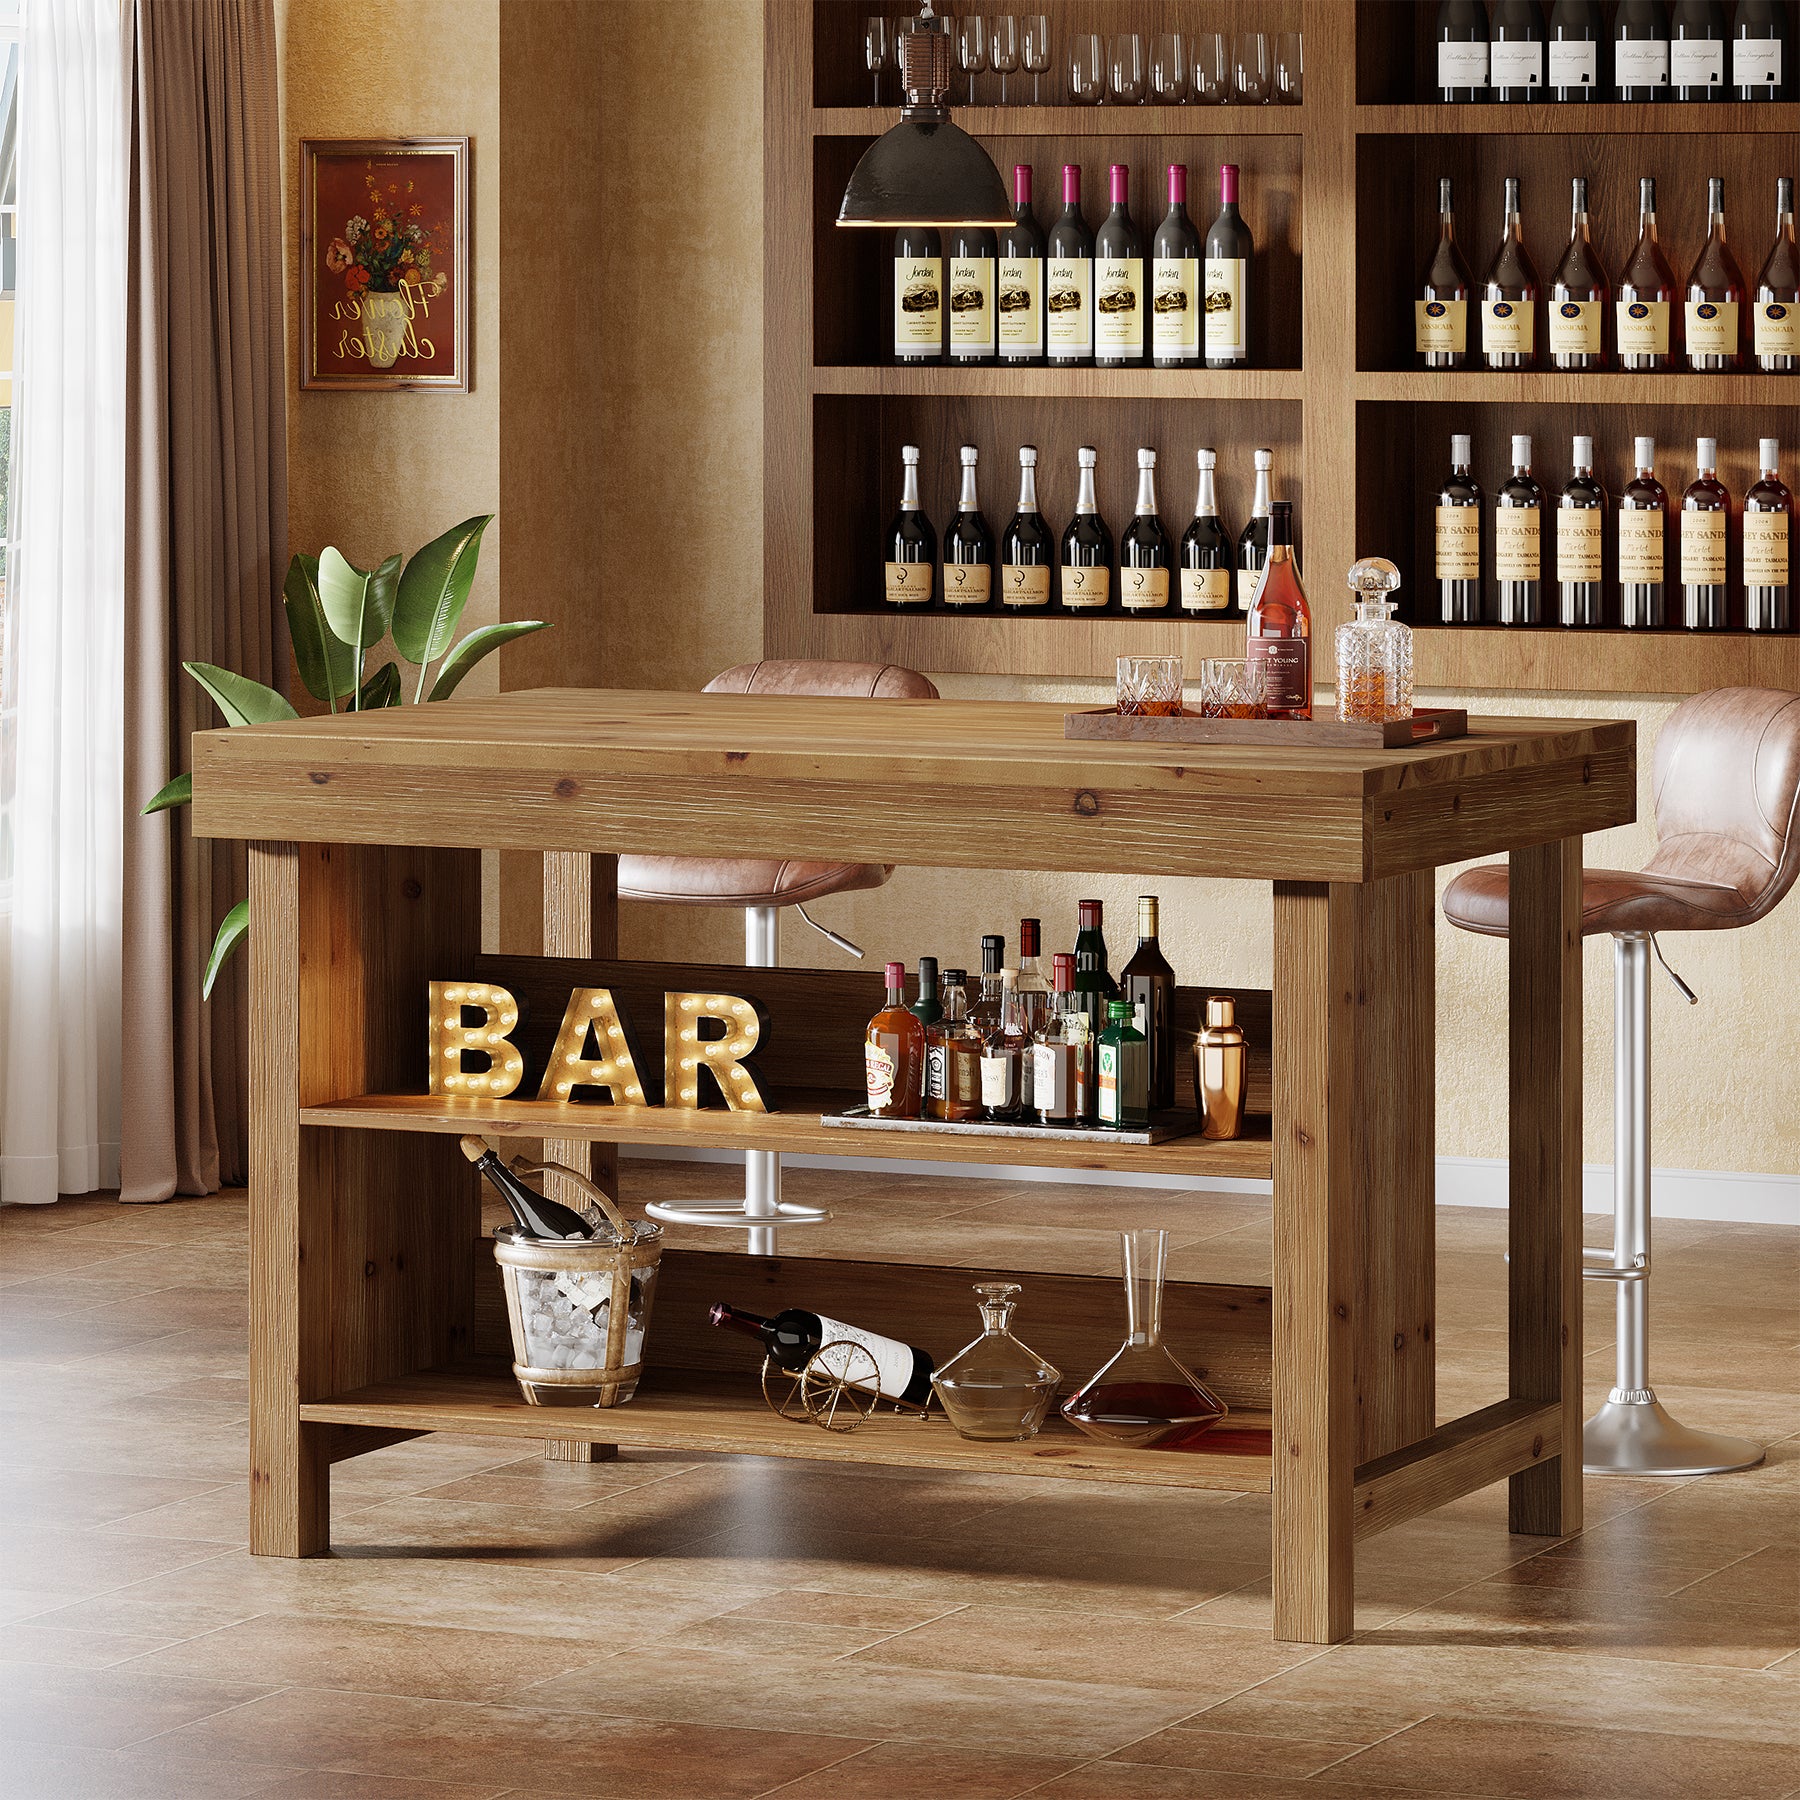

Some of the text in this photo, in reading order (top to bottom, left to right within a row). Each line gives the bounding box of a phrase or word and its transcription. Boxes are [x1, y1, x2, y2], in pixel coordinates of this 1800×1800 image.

[906, 266, 934, 280] Jordan
[1101, 266, 1129, 280] Jordan
[429, 980, 768, 1113] BAR
